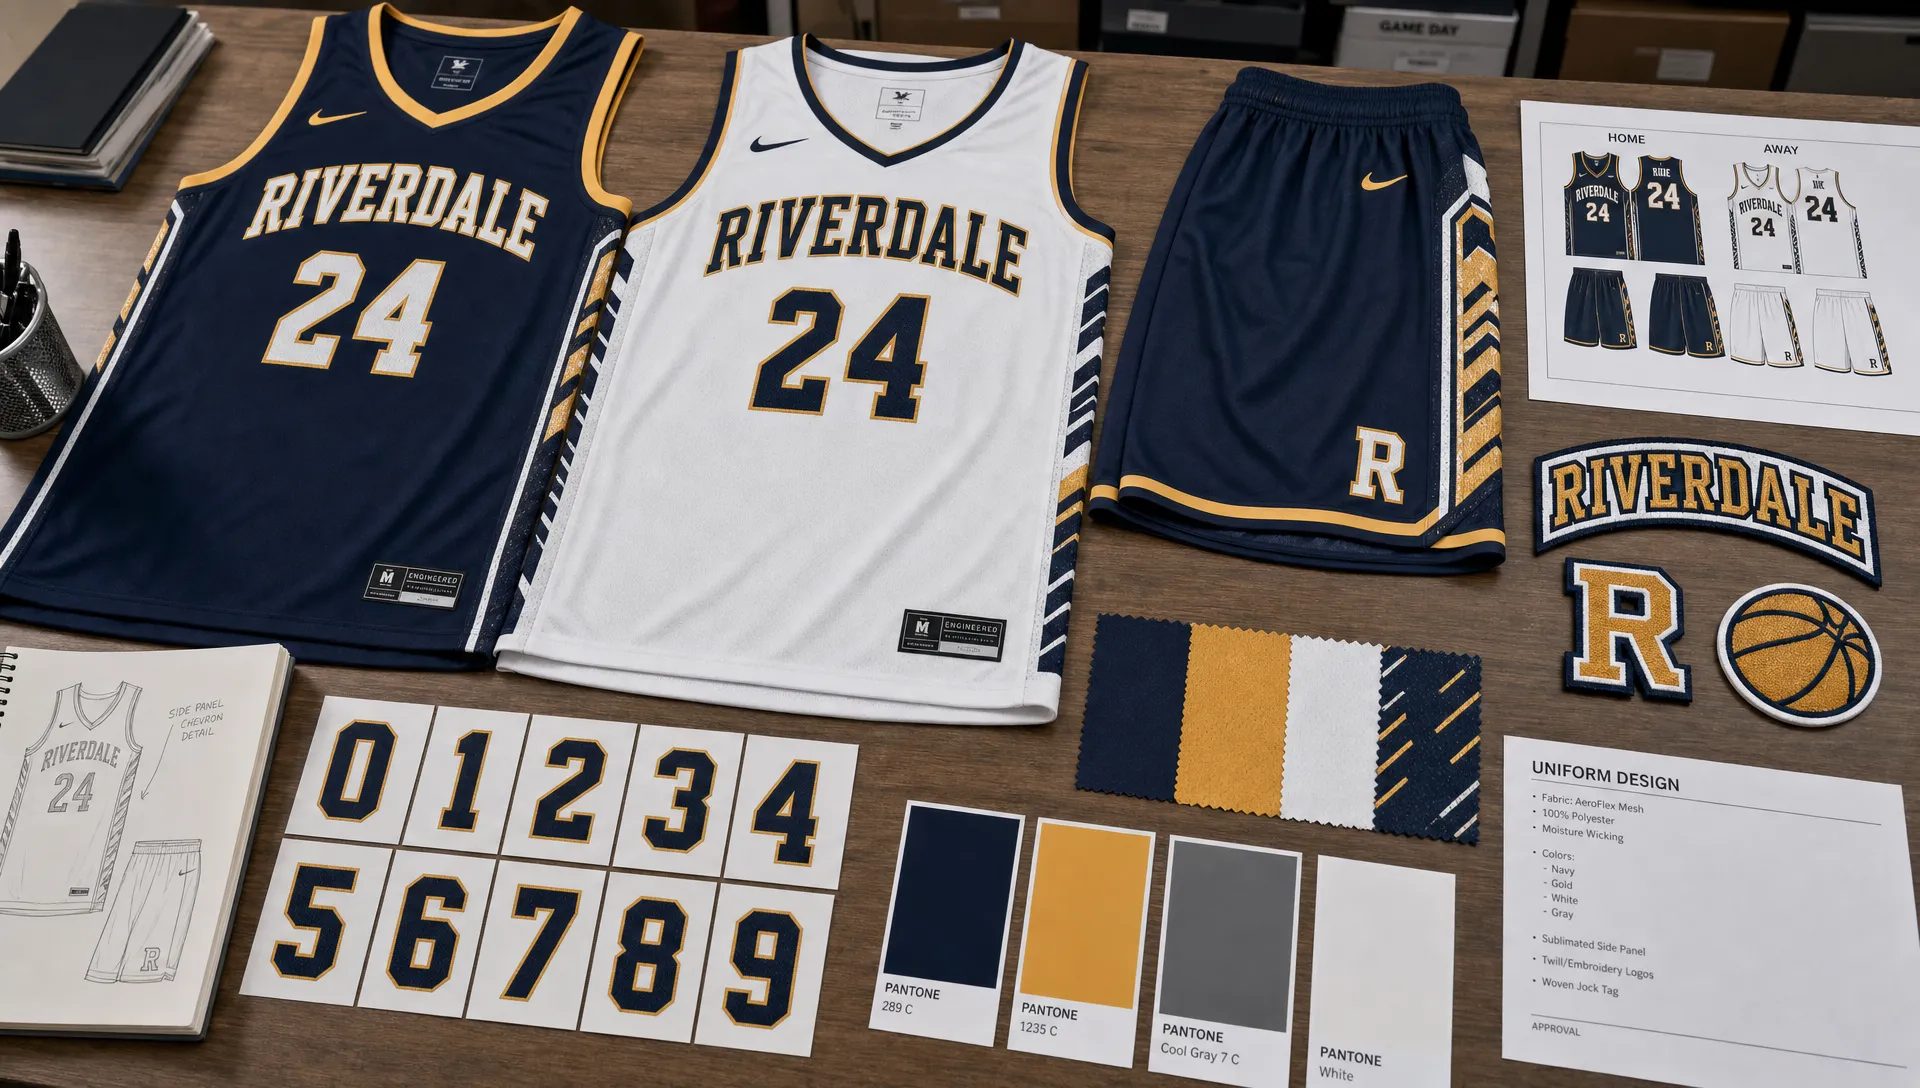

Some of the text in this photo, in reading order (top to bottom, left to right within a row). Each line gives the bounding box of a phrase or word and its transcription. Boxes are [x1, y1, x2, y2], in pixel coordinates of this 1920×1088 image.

[1379, 20, 1460, 37] GAME DAY
[1608, 133, 1645, 144] HOME
[1764, 144, 1798, 155] AWAY
[1576, 185, 1618, 204] RIVERDALE
[1647, 181, 1680, 210] 24
[242, 163, 549, 262] RIVERDALE
[1586, 202, 1610, 223] 24
[1739, 197, 1782, 217] RIVERDALE
[1805, 195, 1838, 223] 24
[1751, 217, 1775, 237] 24
[703, 194, 1029, 298] RIVERDALE
[261, 250, 446, 378] 24
[1619, 333, 1627, 344] R
[1705, 341, 1714, 351] R
[748, 286, 931, 424] 24
[1784, 351, 1793, 362] R
[1869, 358, 1878, 369] R
[1349, 426, 1406, 504] R
[1548, 450, 1865, 564] RIVERDALE
[379, 571, 394, 584] M
[915, 620, 930, 634] M
[1565, 557, 1692, 703] R
[168, 699, 224, 719] SIDE PANEL
[180, 713, 224, 729] CHEVRON
[181, 727, 214, 741] DETAIL
[41, 740, 121, 772] RIVERDALE
[317, 719, 398, 823] 0
[438, 729, 492, 832] 1
[1532, 760, 1680, 792] UNIFORM DESIGN
[47, 772, 96, 813] 24
[529, 737, 608, 844] 2
[643, 747, 718, 853] 3
[751, 759, 821, 867] 4
[1542, 793, 1644, 814] Fabric: AeroFlex Mesh
[1542, 808, 1615, 825] 100% Polyester
[1542, 824, 1624, 844] Moisture Wicking
[1542, 849, 1575, 861] Colors:
[1551, 864, 1575, 877] Navy
[1551, 879, 1573, 890] Gold
[1551, 893, 1578, 905] White
[270, 862, 360, 981] 5
[1551, 907, 1574, 921] Gray
[386, 873, 469, 992] 6
[500, 883, 582, 1002] 7
[1542, 934, 1646, 956] Sublimated Side Panel
[140, 947, 160, 971] R
[607, 896, 689, 1016] 8
[722, 908, 803, 1030] 9
[1542, 955, 1654, 980] Twill/Embroidery Logos
[885, 982, 941, 1000] PANTONE
[1542, 977, 1619, 998] Woven Jock Tag
[882, 1001, 914, 1015] 289 C
[1021, 1002, 1078, 1021] PANTONE
[1020, 1021, 1058, 1036] 1235 C
[1162, 1023, 1224, 1043] PANTONE
[1532, 1022, 1581, 1037] APPROVAL
[1160, 1042, 1240, 1065] Cool Gray 7 C
[1320, 1046, 1382, 1067] PANTONE
[1319, 1065, 1354, 1081] White
